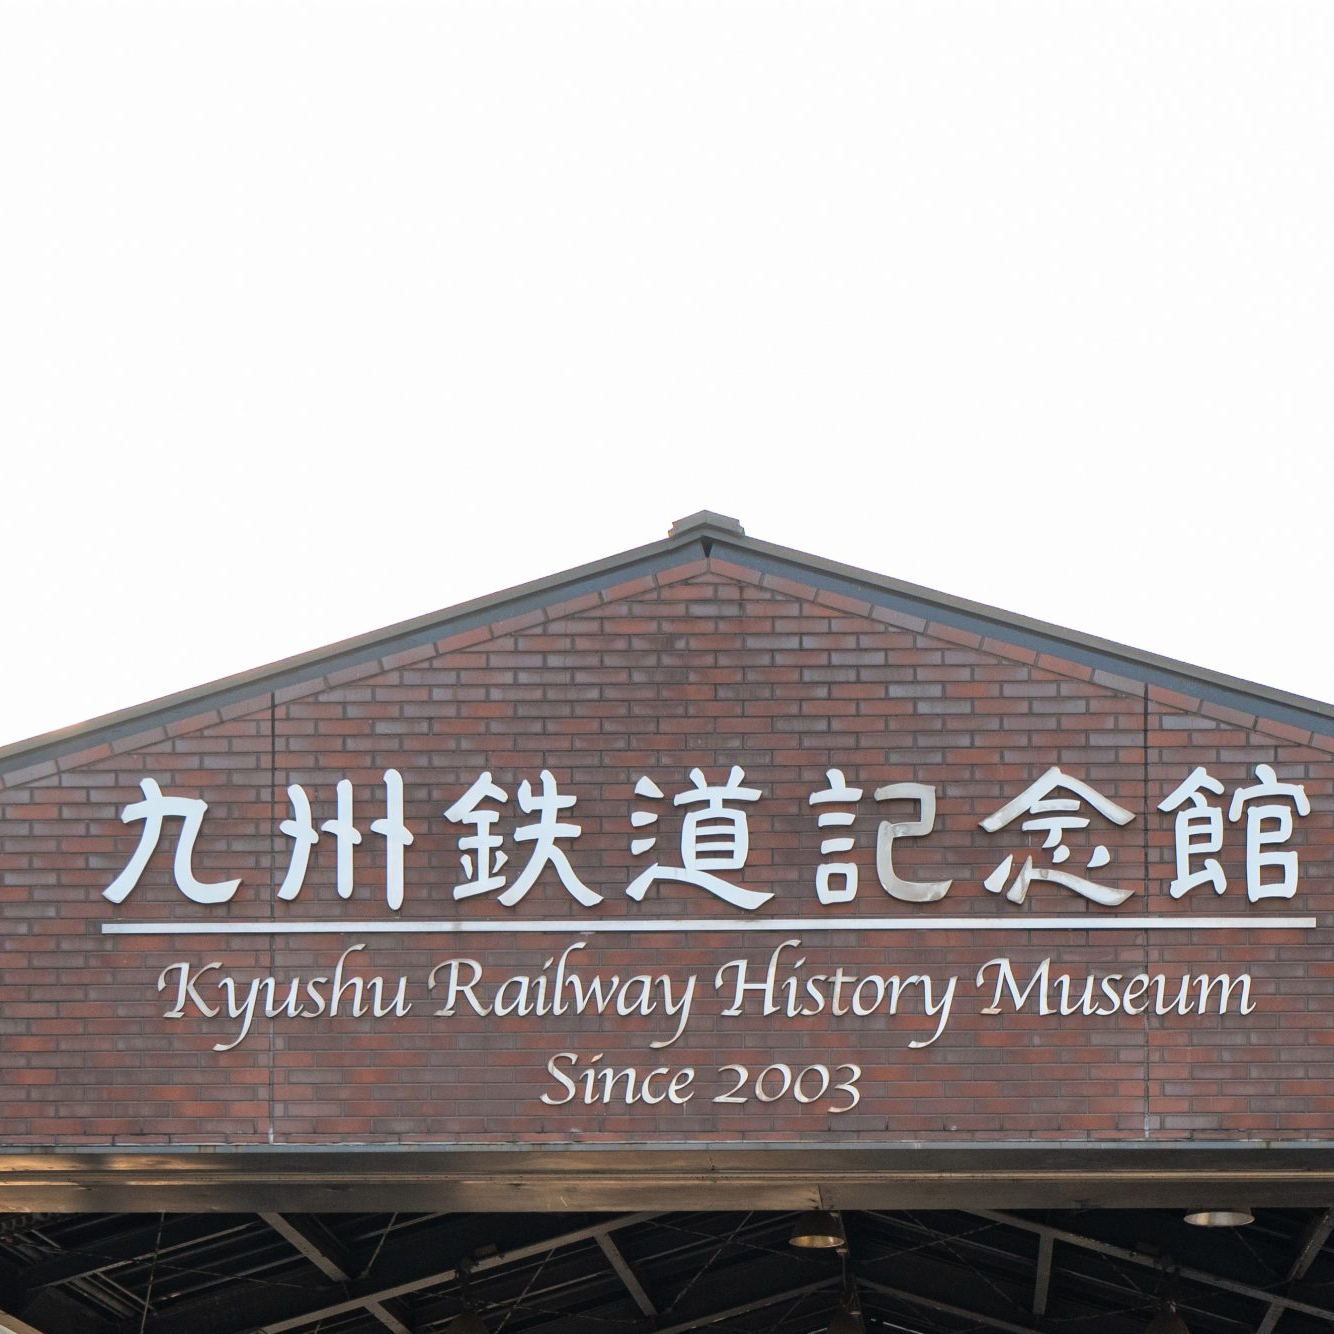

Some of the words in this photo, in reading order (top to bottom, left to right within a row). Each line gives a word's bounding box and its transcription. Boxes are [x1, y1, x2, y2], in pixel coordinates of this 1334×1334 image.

[102, 764, 1311, 910] 九州鉄道記念館
[158, 944, 409, 1051] Kyushu
[428, 942, 696, 1048] Railway
[715, 940, 958, 1048] History
[976, 958, 1256, 1016] Museum
[540, 1052, 695, 1105] Since
[713, 1064, 862, 1112] 2003
